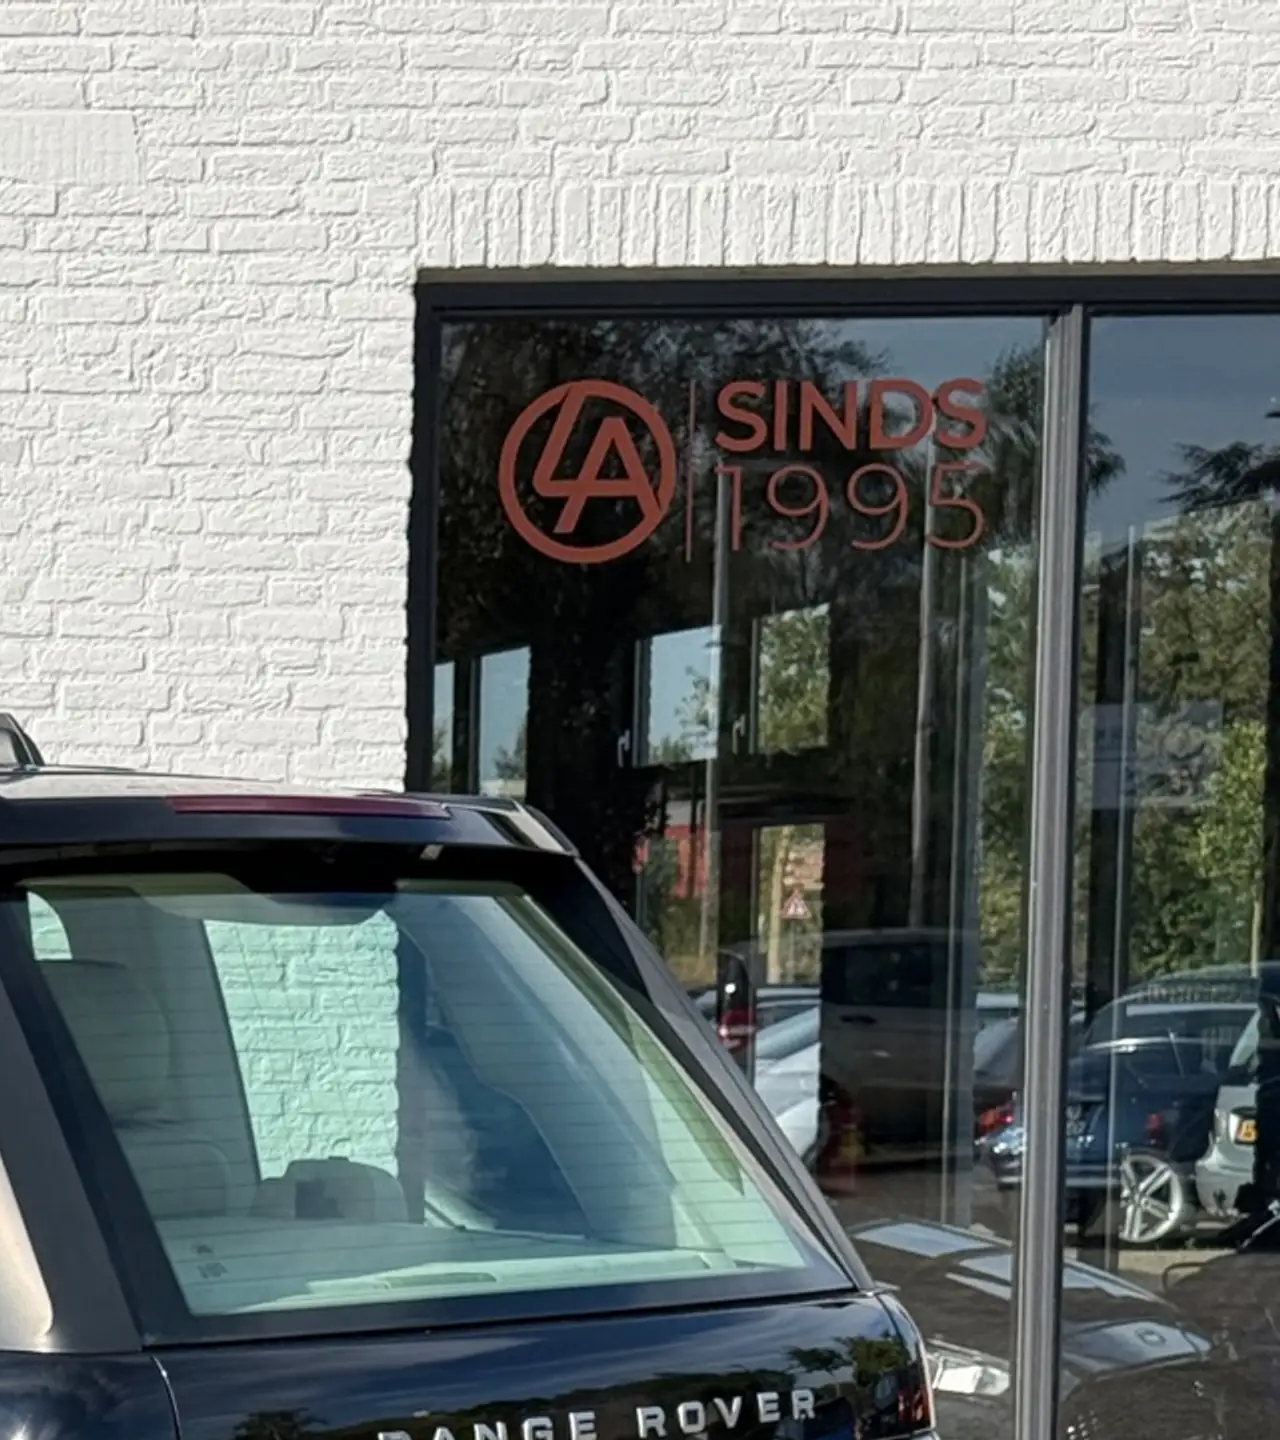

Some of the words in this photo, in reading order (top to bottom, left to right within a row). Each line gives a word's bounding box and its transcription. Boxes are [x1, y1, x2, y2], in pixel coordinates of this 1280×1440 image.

[715, 378, 987, 452] SINDS
[715, 462, 986, 551] 1995
[635, 1389, 817, 1440] ROVER
